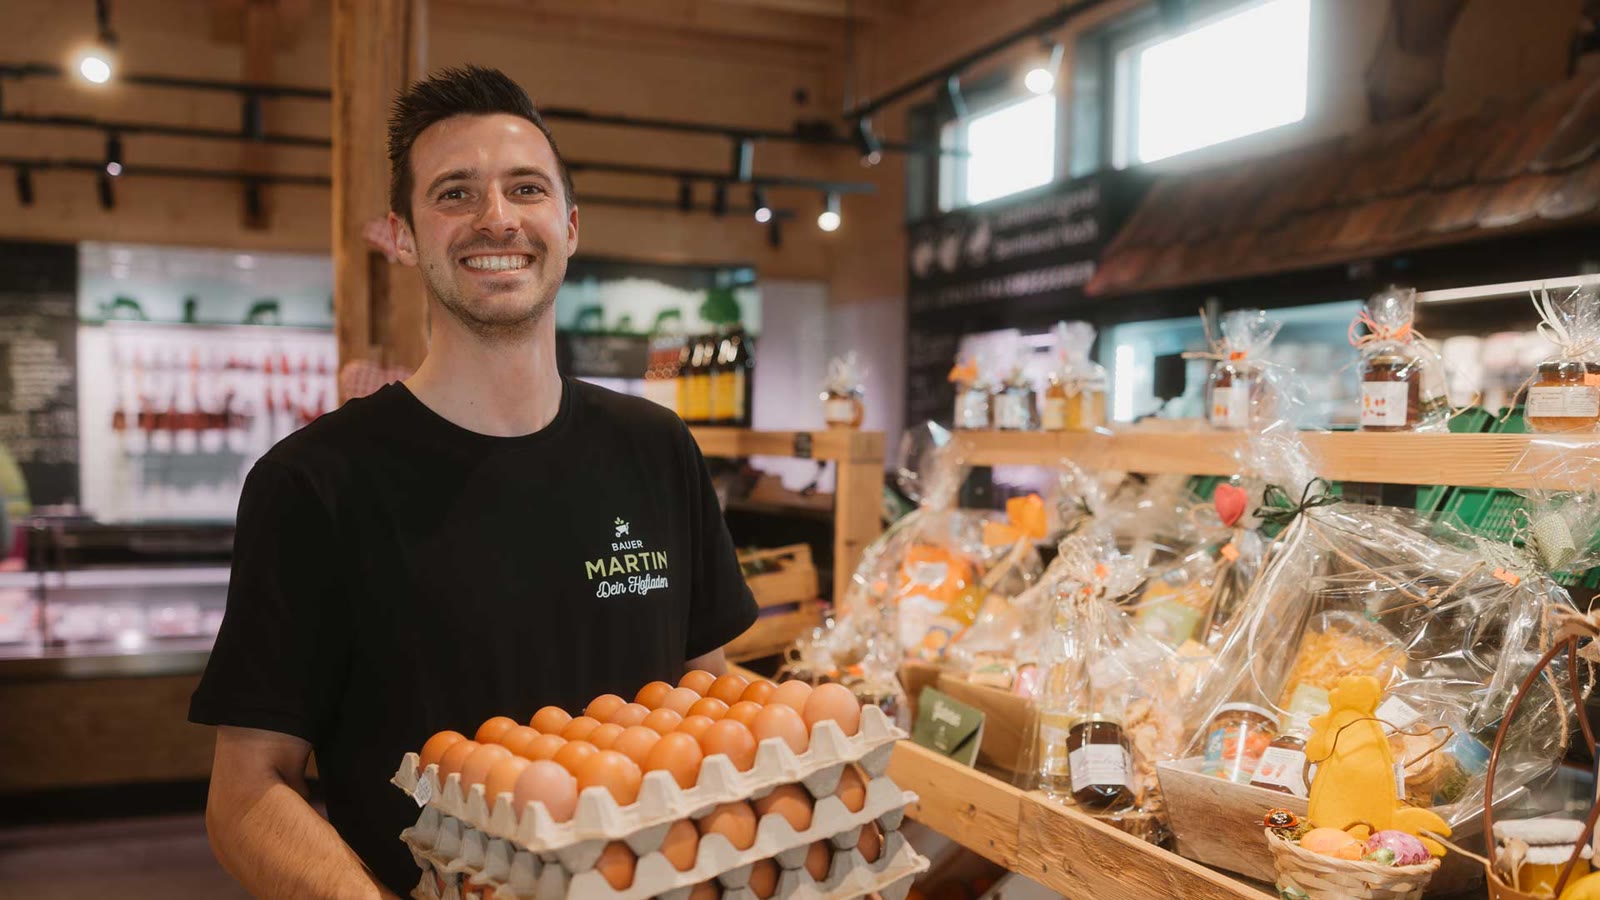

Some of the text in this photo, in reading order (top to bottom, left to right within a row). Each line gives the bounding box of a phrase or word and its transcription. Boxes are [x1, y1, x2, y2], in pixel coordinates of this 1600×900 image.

[611, 540, 643, 551] BAUER
[585, 551, 668, 580] MARTIN
[596, 573, 668, 598] Dein Hofladen
